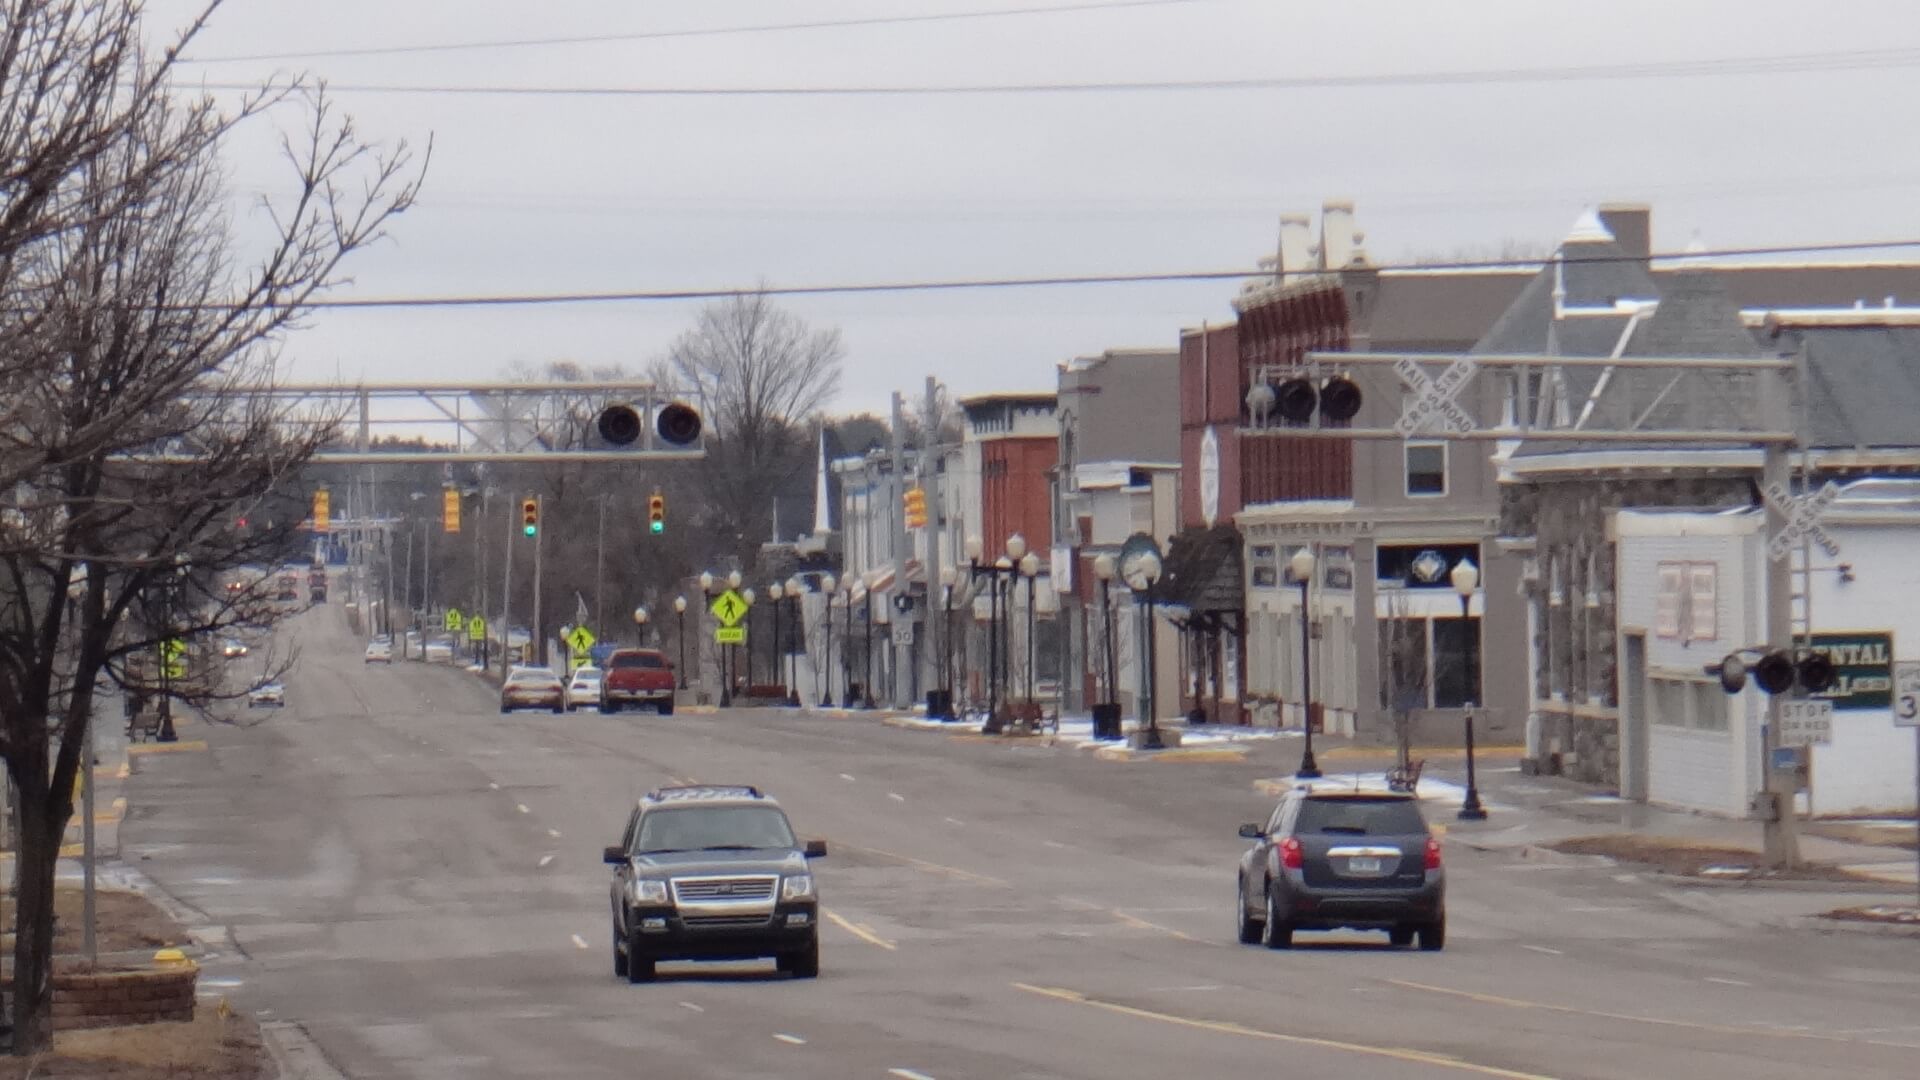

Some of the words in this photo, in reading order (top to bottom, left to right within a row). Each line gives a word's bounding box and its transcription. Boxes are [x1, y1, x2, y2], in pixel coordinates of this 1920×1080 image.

[1398, 359, 1426, 390] RAIL
[1439, 400, 1472, 433] ROAD
[1400, 359, 1470, 433] CROSSING
[1769, 485, 1796, 513] RAIL
[1809, 526, 1839, 557] ROAD
[1783, 703, 1831, 718] STOP
